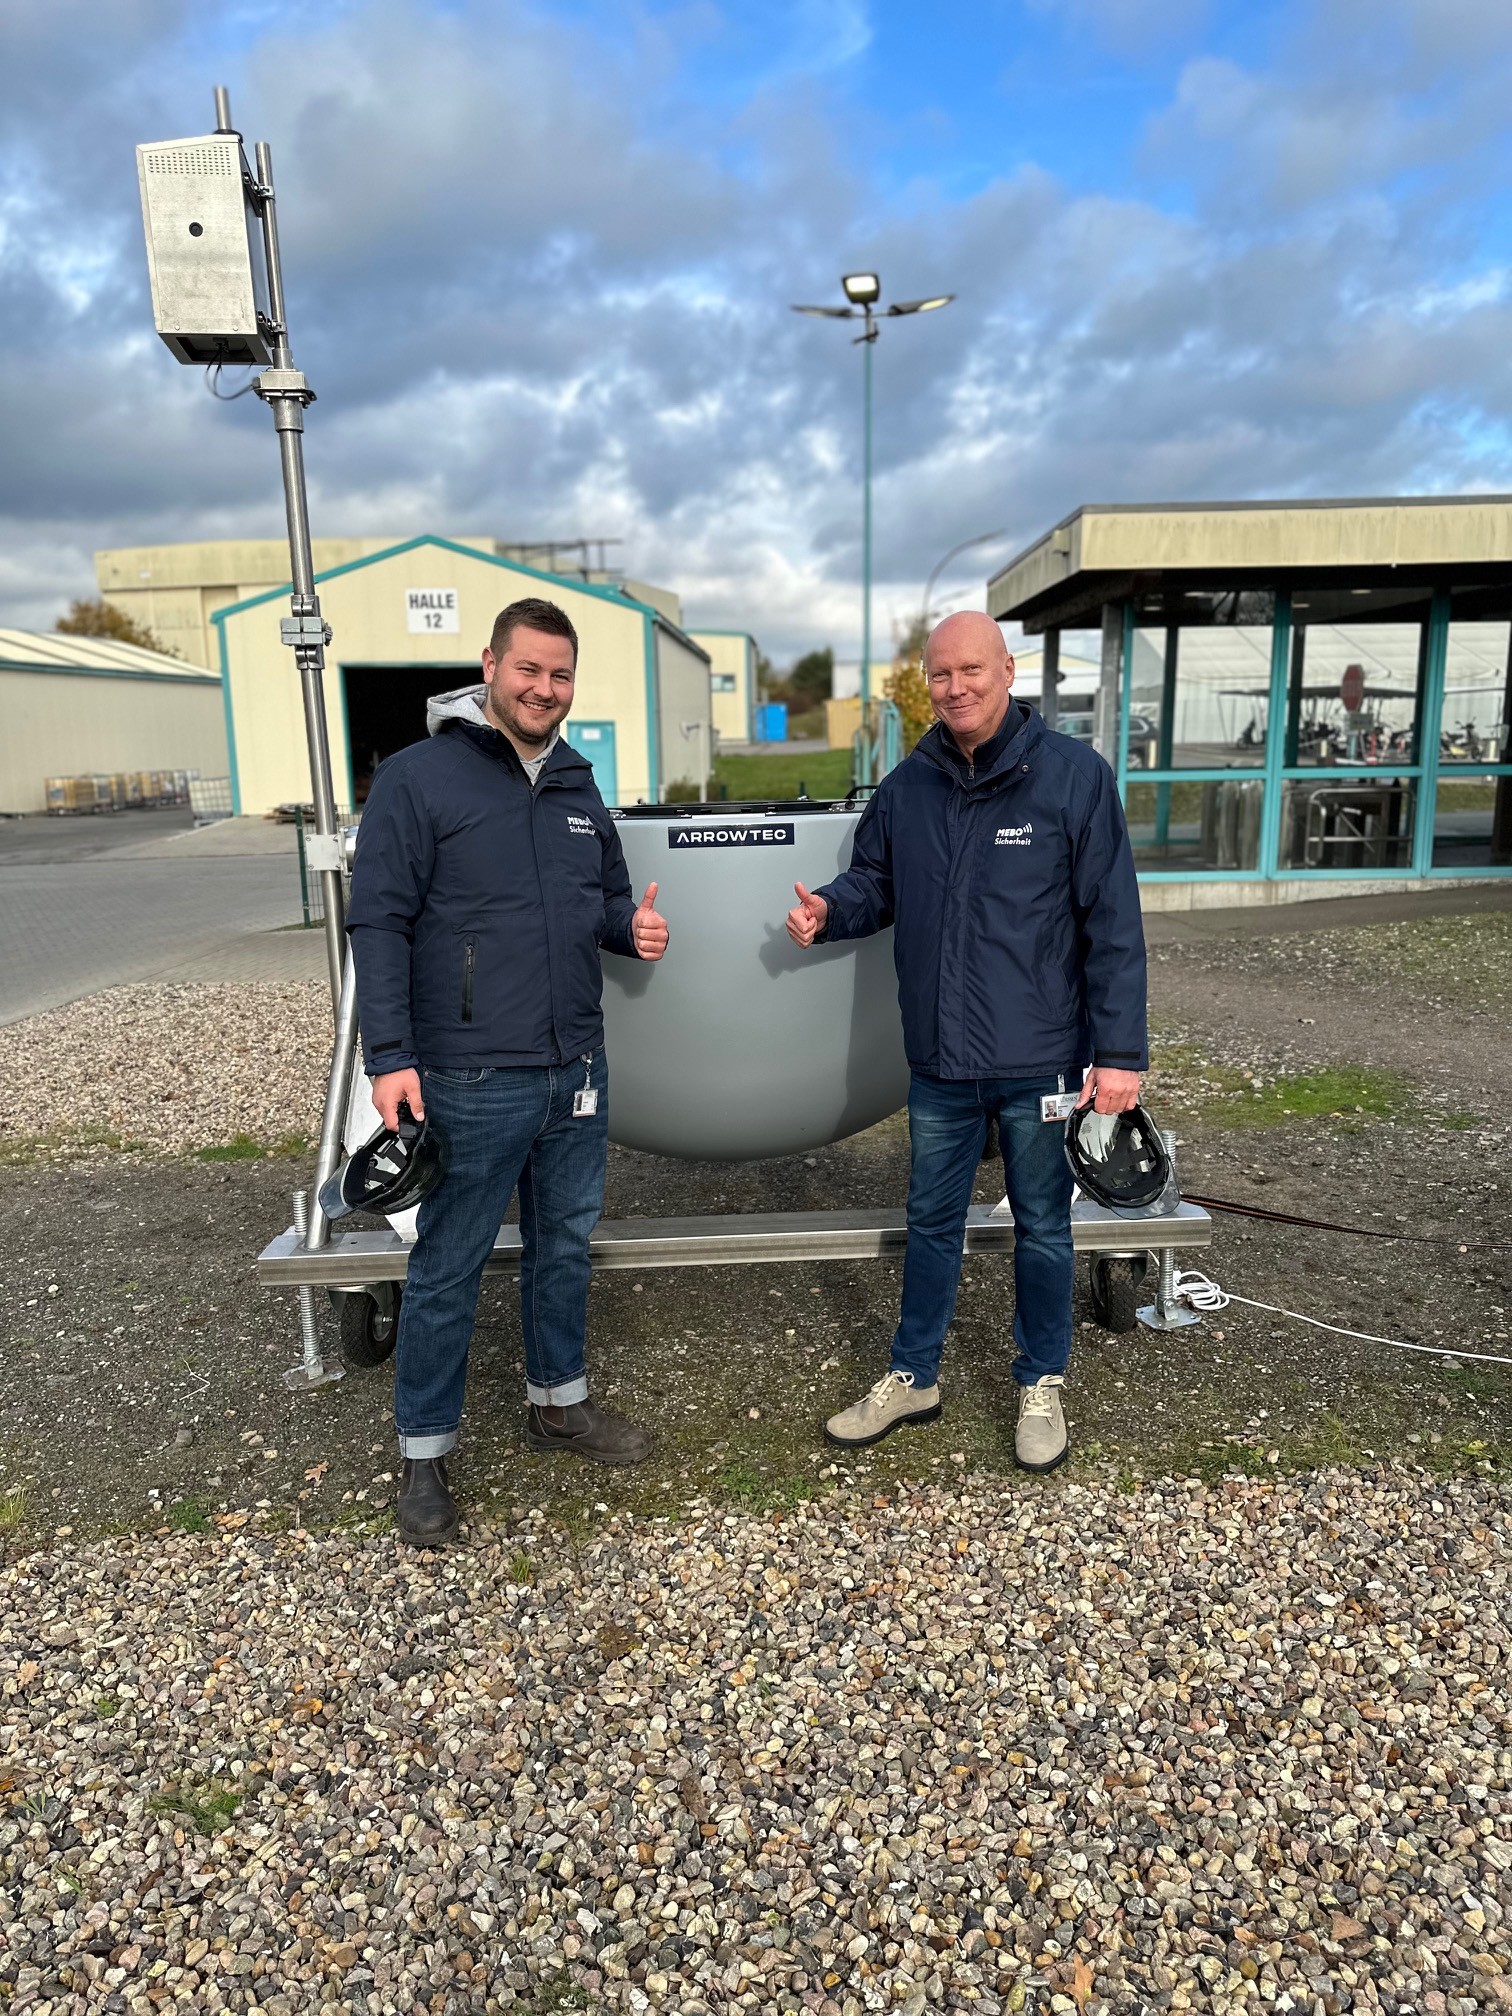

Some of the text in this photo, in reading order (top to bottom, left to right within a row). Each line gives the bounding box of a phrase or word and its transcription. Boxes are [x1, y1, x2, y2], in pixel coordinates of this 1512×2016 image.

[409, 593, 454, 609] HALLE
[424, 613, 443, 628] 12
[676, 829, 787, 843] ARROWTEC
[996, 828, 1023, 837] MEBO
[994, 837, 1032, 846] Sicherheit
